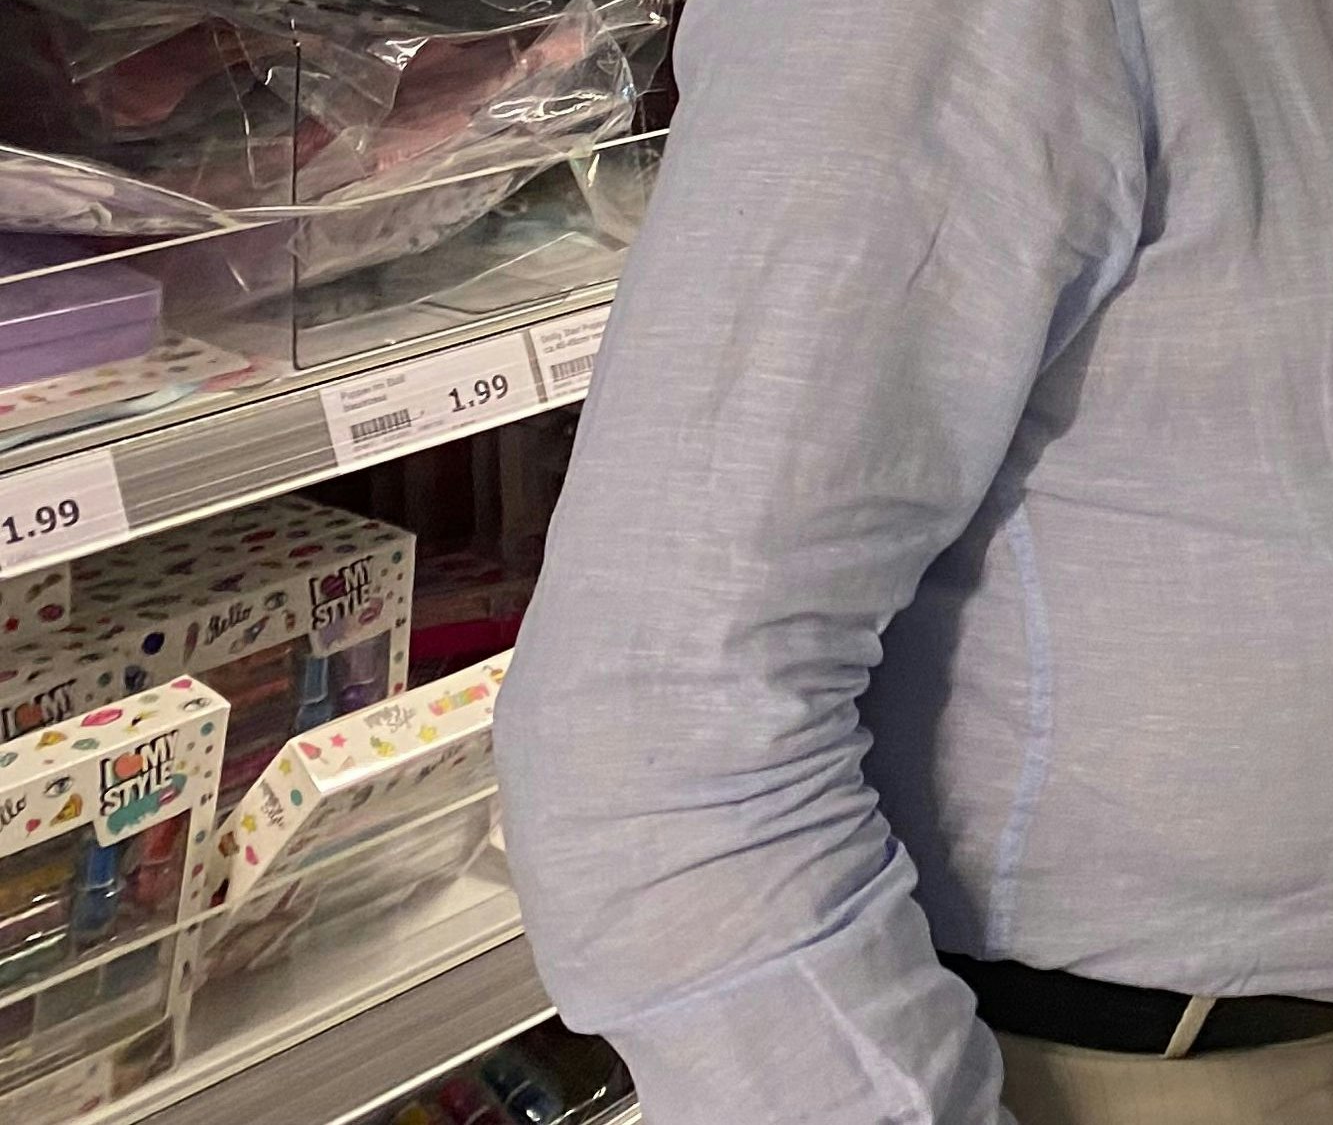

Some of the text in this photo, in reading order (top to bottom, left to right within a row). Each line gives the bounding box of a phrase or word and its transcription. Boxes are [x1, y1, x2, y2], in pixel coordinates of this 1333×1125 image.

[448, 375, 509, 413] 1.99
[1, 499, 81, 545] 1.99
[100, 730, 180, 789] I MY
[100, 763, 174, 817] STYLE
